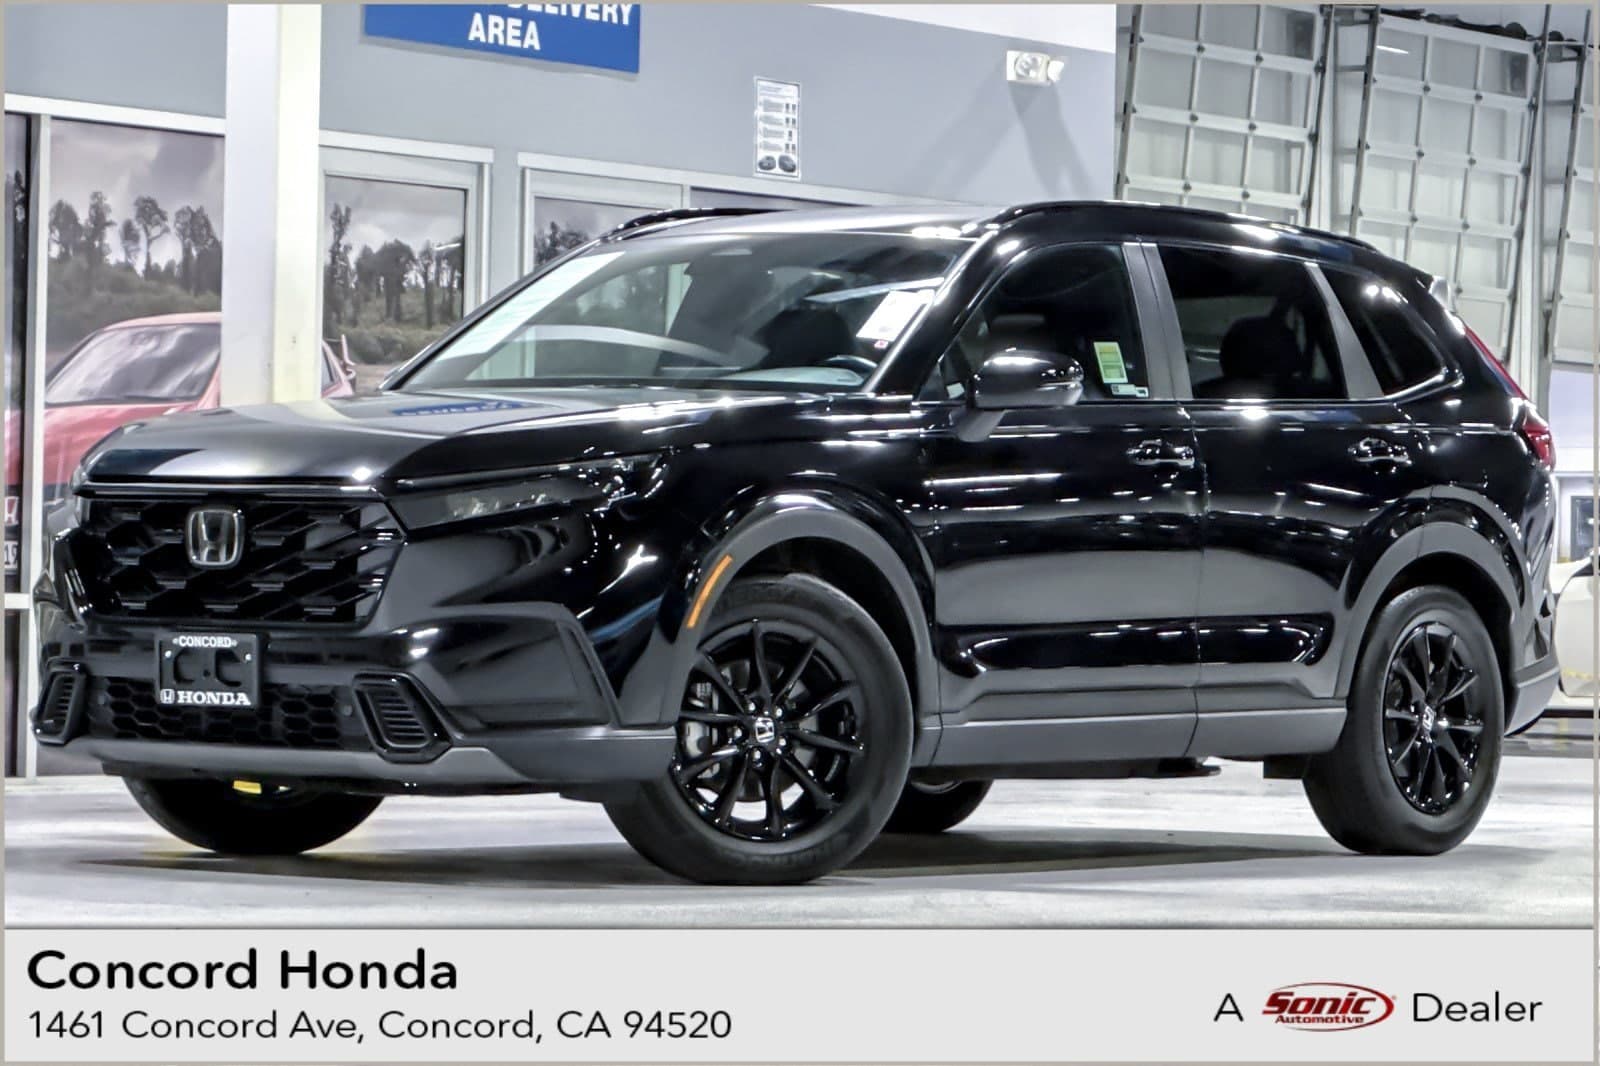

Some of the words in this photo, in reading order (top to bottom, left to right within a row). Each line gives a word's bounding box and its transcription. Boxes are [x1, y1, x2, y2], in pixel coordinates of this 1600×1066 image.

[507, 4, 633, 26] VERY
[468, 12, 541, 50] AREA
[178, 635, 232, 648] CONCORD
[177, 690, 252, 706] HONDA
